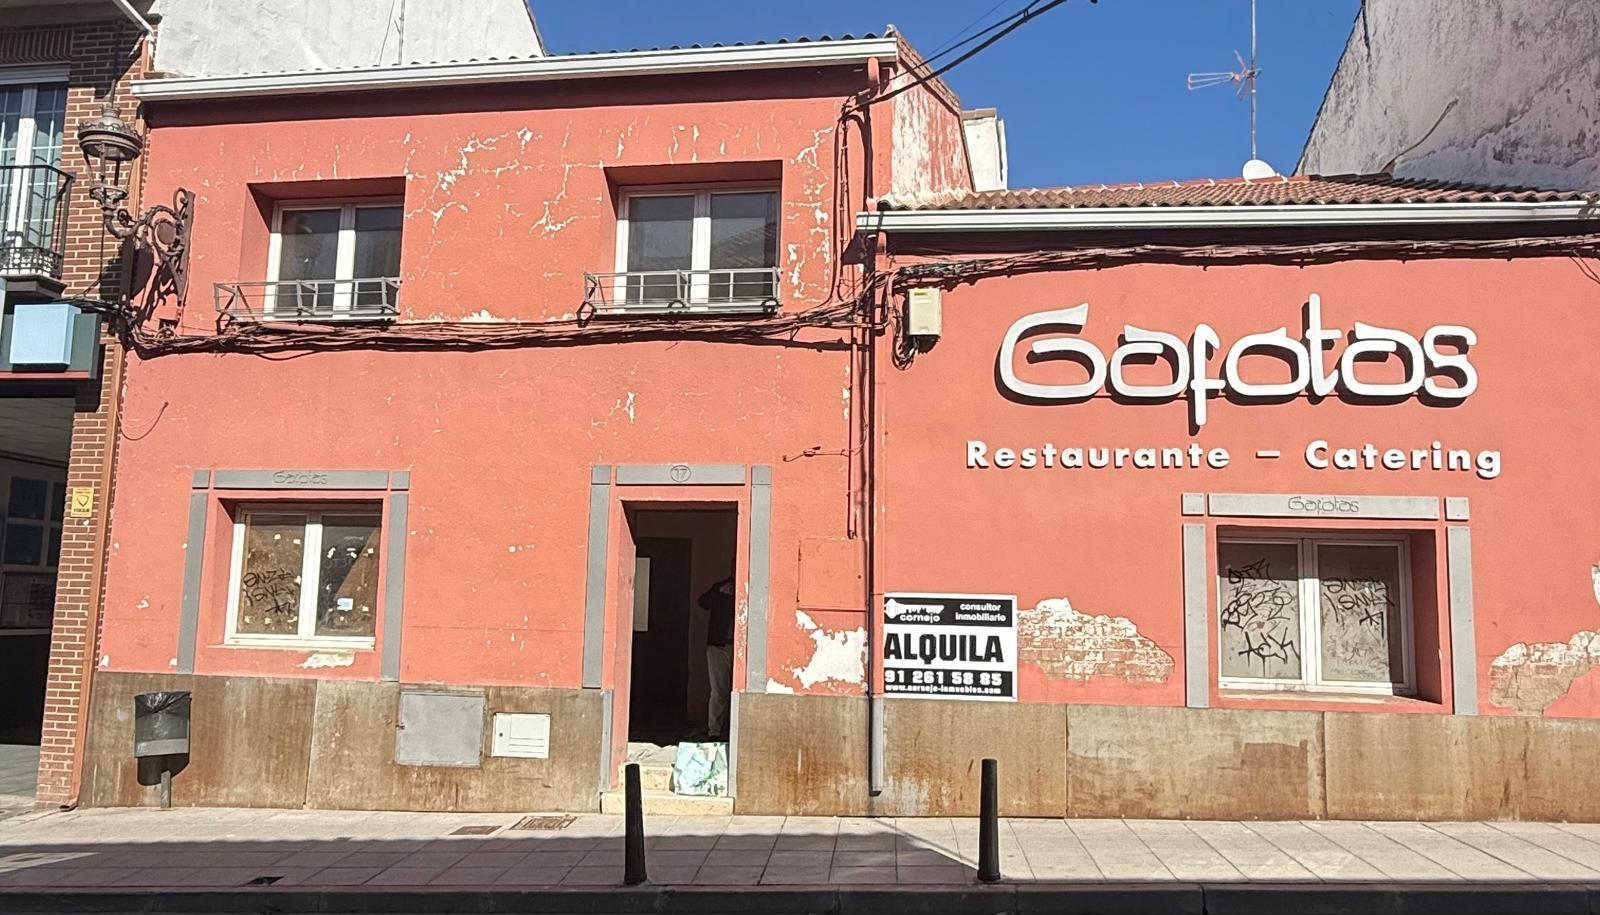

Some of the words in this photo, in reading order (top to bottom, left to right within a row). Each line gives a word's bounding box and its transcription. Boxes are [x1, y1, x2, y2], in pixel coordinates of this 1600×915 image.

[999, 293, 1478, 426] Gafotas
[966, 440, 1230, 468] Restaurante
[1304, 440, 1501, 478] Catering
[959, 603, 1002, 611] consultor
[899, 613, 941, 623] cornejo
[955, 611, 1007, 622] inmobiliario
[884, 632, 1005, 665] ALQUILA
[884, 669, 905, 683] 91
[912, 670, 944, 684] 261
[951, 671, 974, 685] 58
[979, 672, 1003, 686] 85
